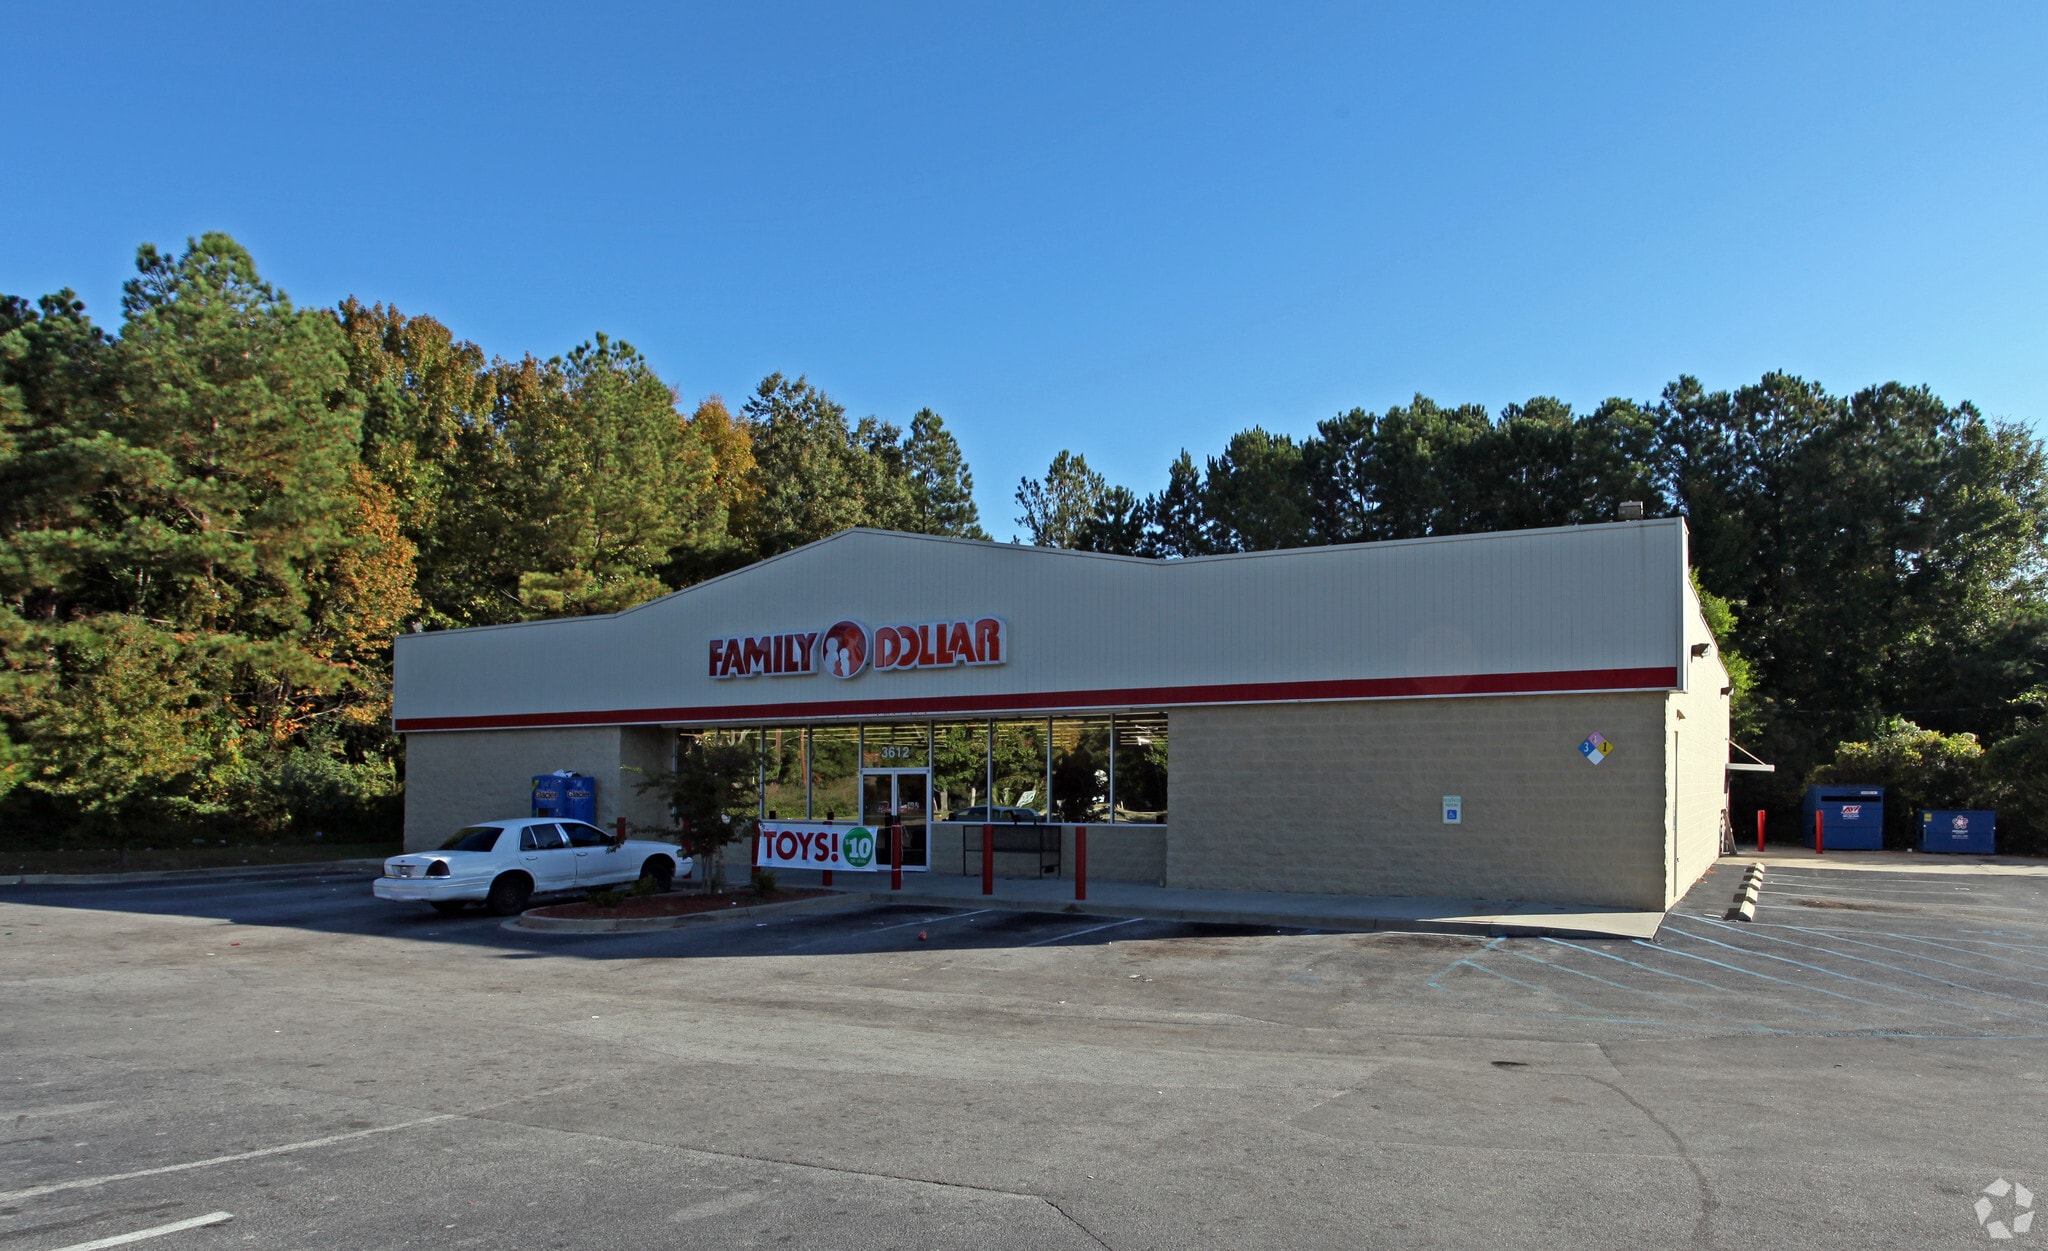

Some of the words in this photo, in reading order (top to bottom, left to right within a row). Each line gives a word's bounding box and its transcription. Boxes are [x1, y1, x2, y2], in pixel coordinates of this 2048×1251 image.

[708, 631, 819, 678] FAMILY
[874, 617, 1001, 669] DOLLAR
[881, 746, 910, 758] 3612
[1583, 741, 1589, 753] 3
[1602, 741, 1608, 752] 1
[535, 790, 557, 799] Glacier
[567, 789, 590, 799] Glacier
[763, 830, 839, 863] TOYS!
